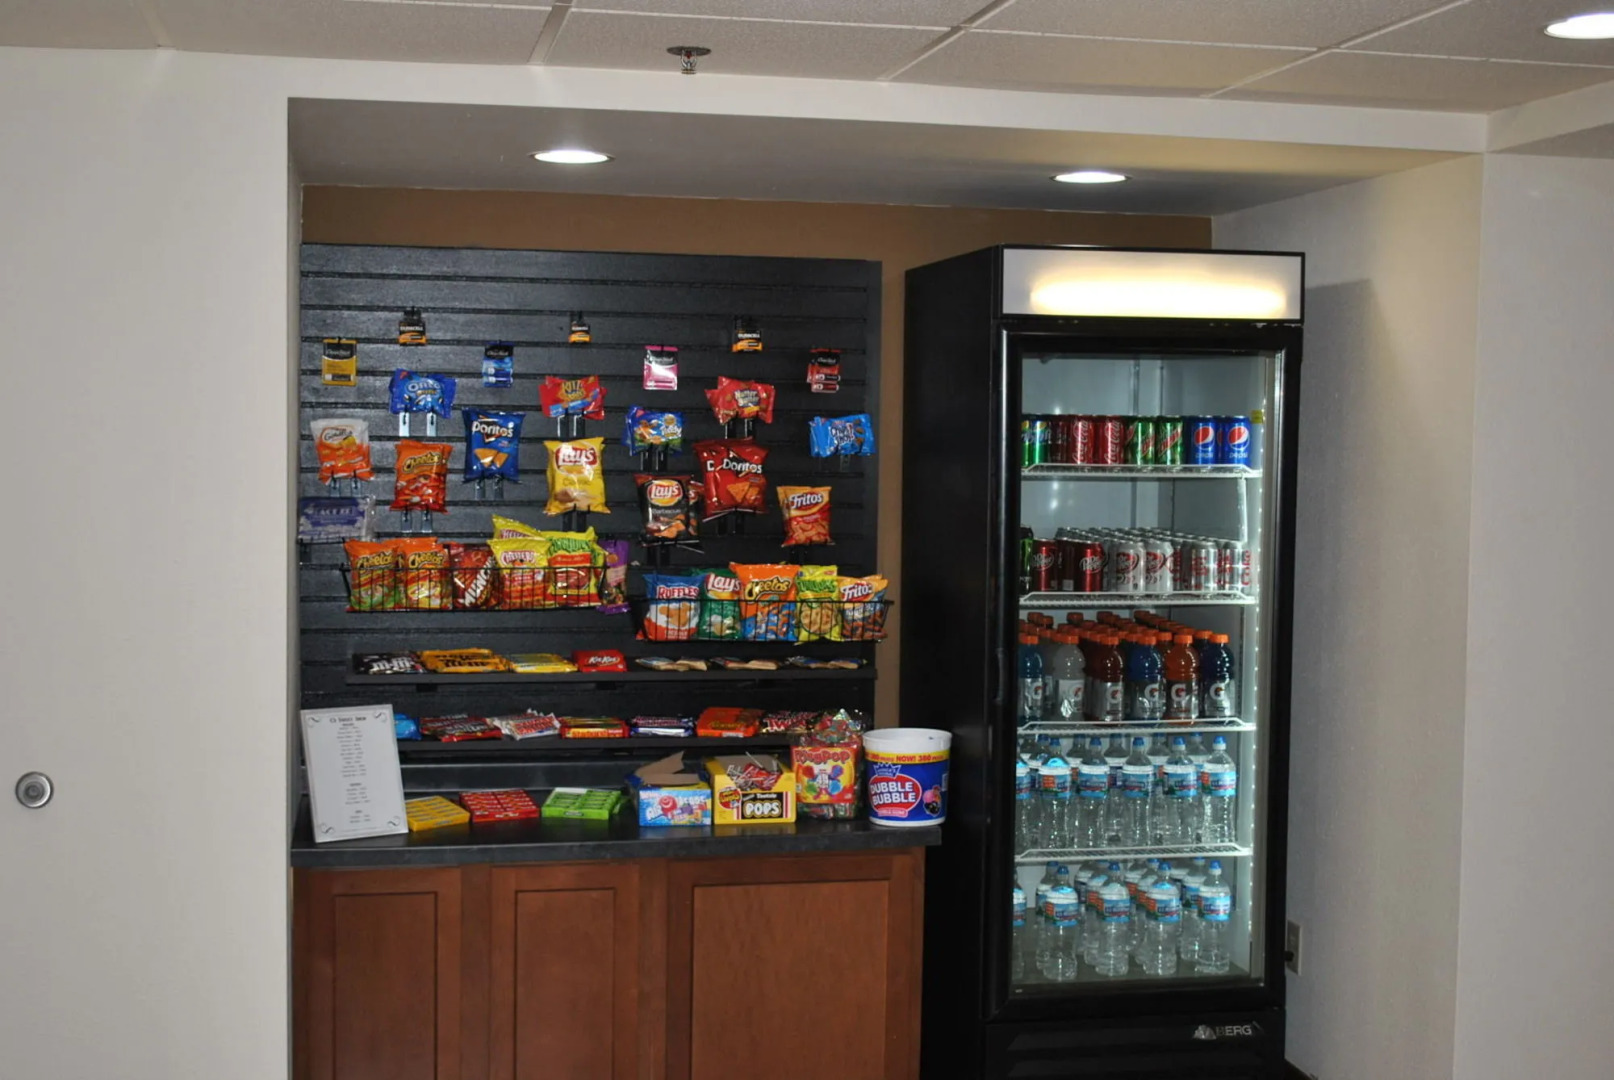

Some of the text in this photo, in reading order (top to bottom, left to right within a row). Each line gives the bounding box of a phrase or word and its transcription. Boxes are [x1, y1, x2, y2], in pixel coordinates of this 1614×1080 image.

[472, 420, 514, 438] Doritos
[403, 451, 442, 474] Cheetos
[722, 458, 763, 474] Doritos
[651, 484, 680, 499] Lay's
[790, 491, 825, 509] Fritos
[707, 573, 742, 593] Lay's
[744, 575, 792, 601] Cheetos
[656, 585, 700, 600] RUFFLES
[1171, 683, 1187, 701] G
[870, 781, 914, 795] DUBBLE
[872, 792, 917, 806] BUBBLE
[744, 801, 780, 816] POPS
